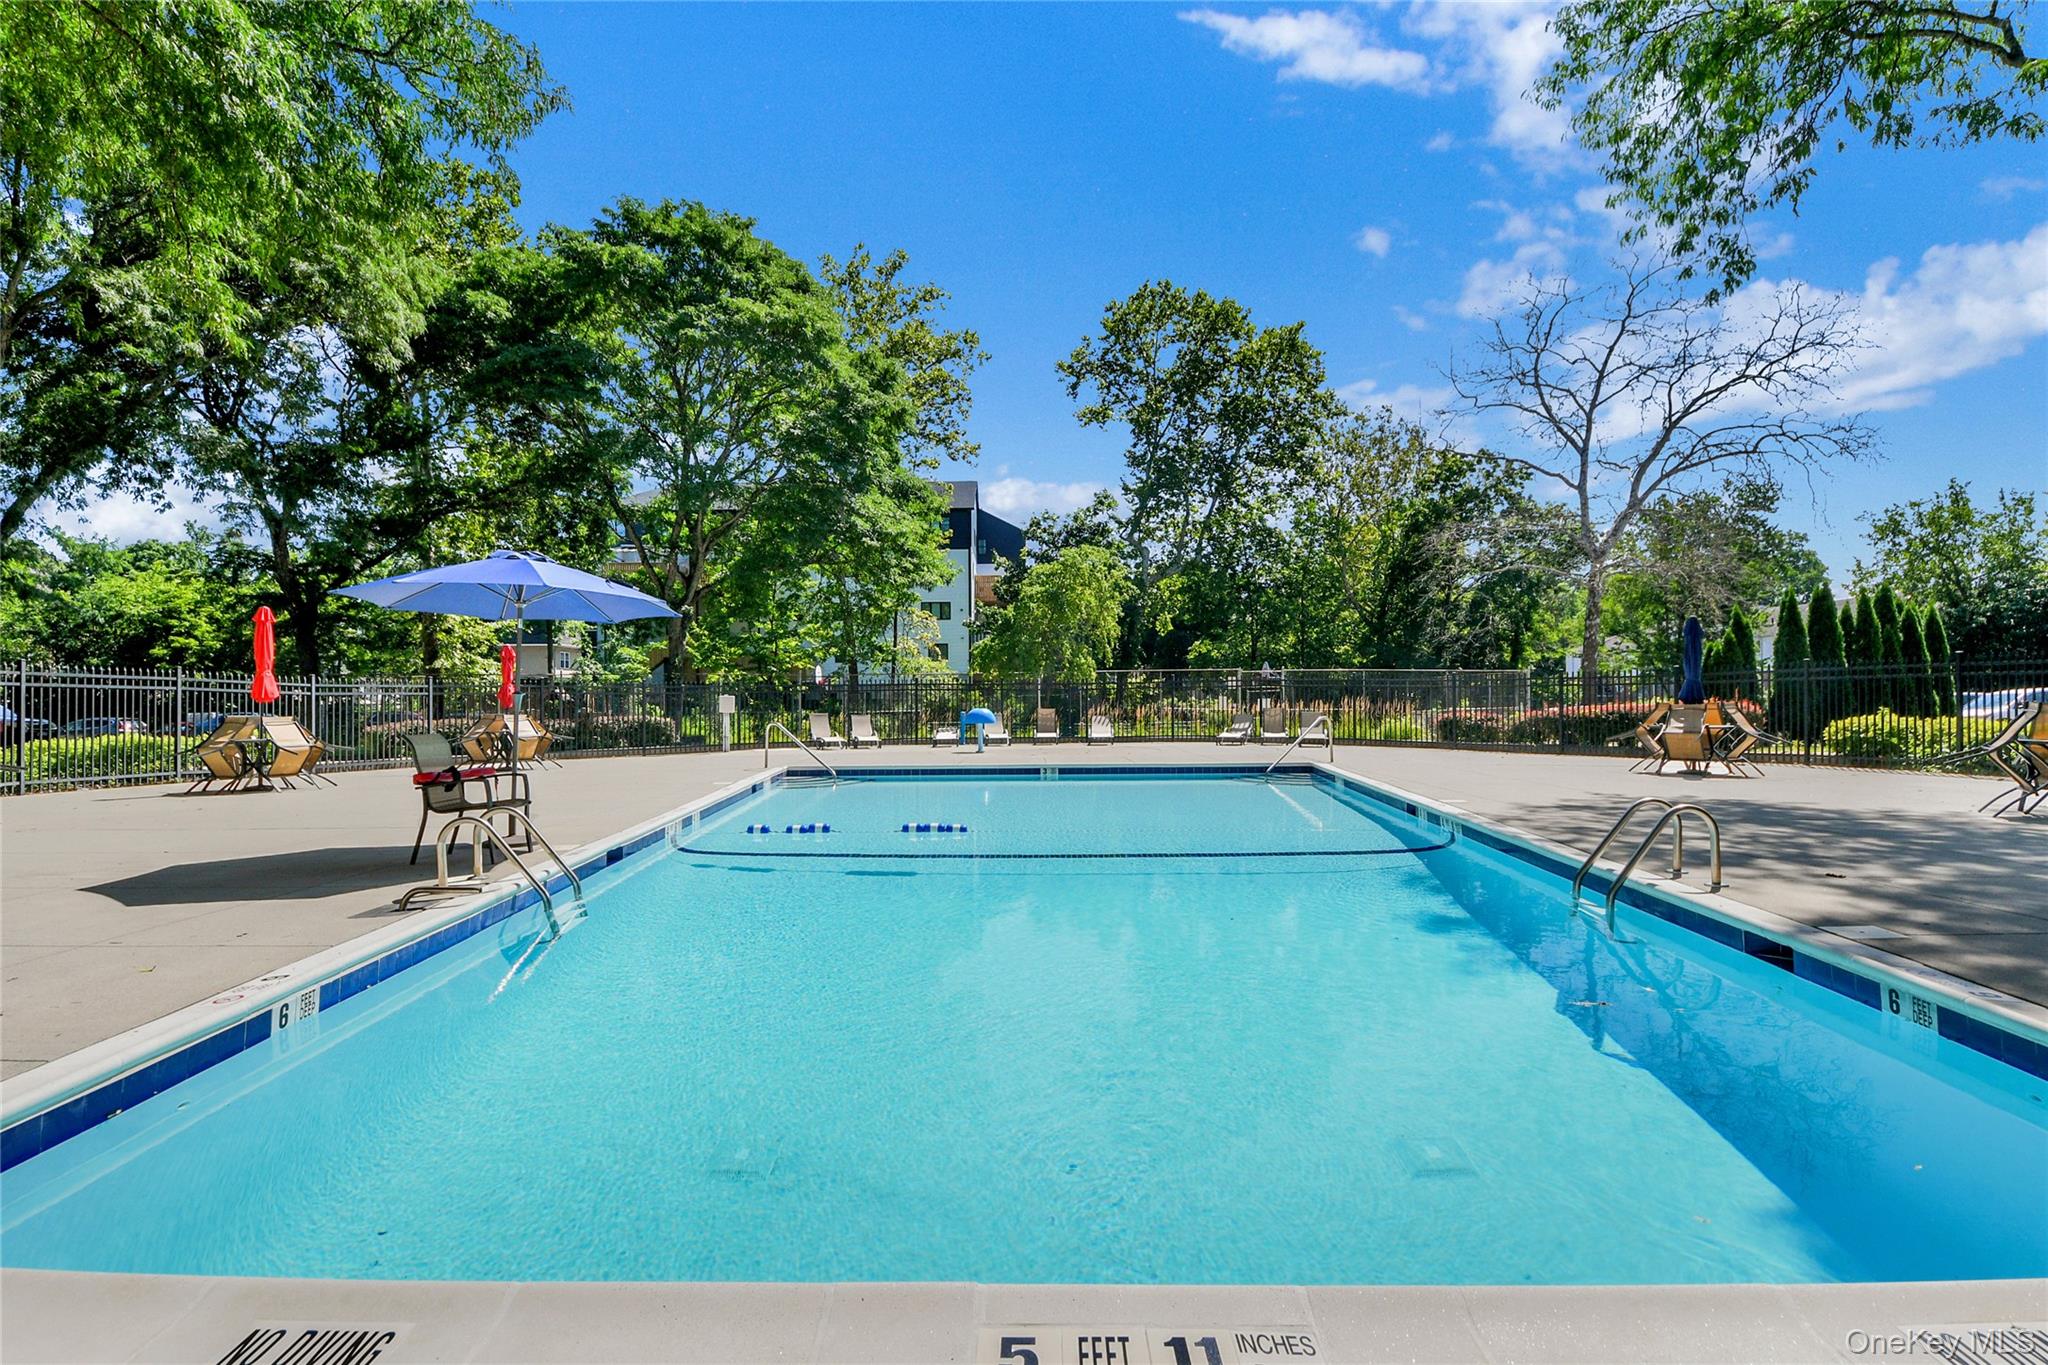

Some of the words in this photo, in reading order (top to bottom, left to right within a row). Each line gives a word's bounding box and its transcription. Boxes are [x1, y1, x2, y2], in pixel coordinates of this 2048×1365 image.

[301, 989, 316, 1008] FEET
[1888, 988, 1900, 1015] 6
[1912, 996, 1931, 1017] FEET
[278, 1003, 289, 1029] 6
[300, 1002, 316, 1020] DEEP
[1913, 1009, 1932, 1028] DEEP
[216, 1329, 287, 1365] NO
[271, 1330, 396, 1365] DIVING
[1000, 1336, 1039, 1365] 5
[1078, 1336, 1129, 1365] FEET
[1164, 1336, 1223, 1365] 11
[1235, 1333, 1316, 1356] INCHES
